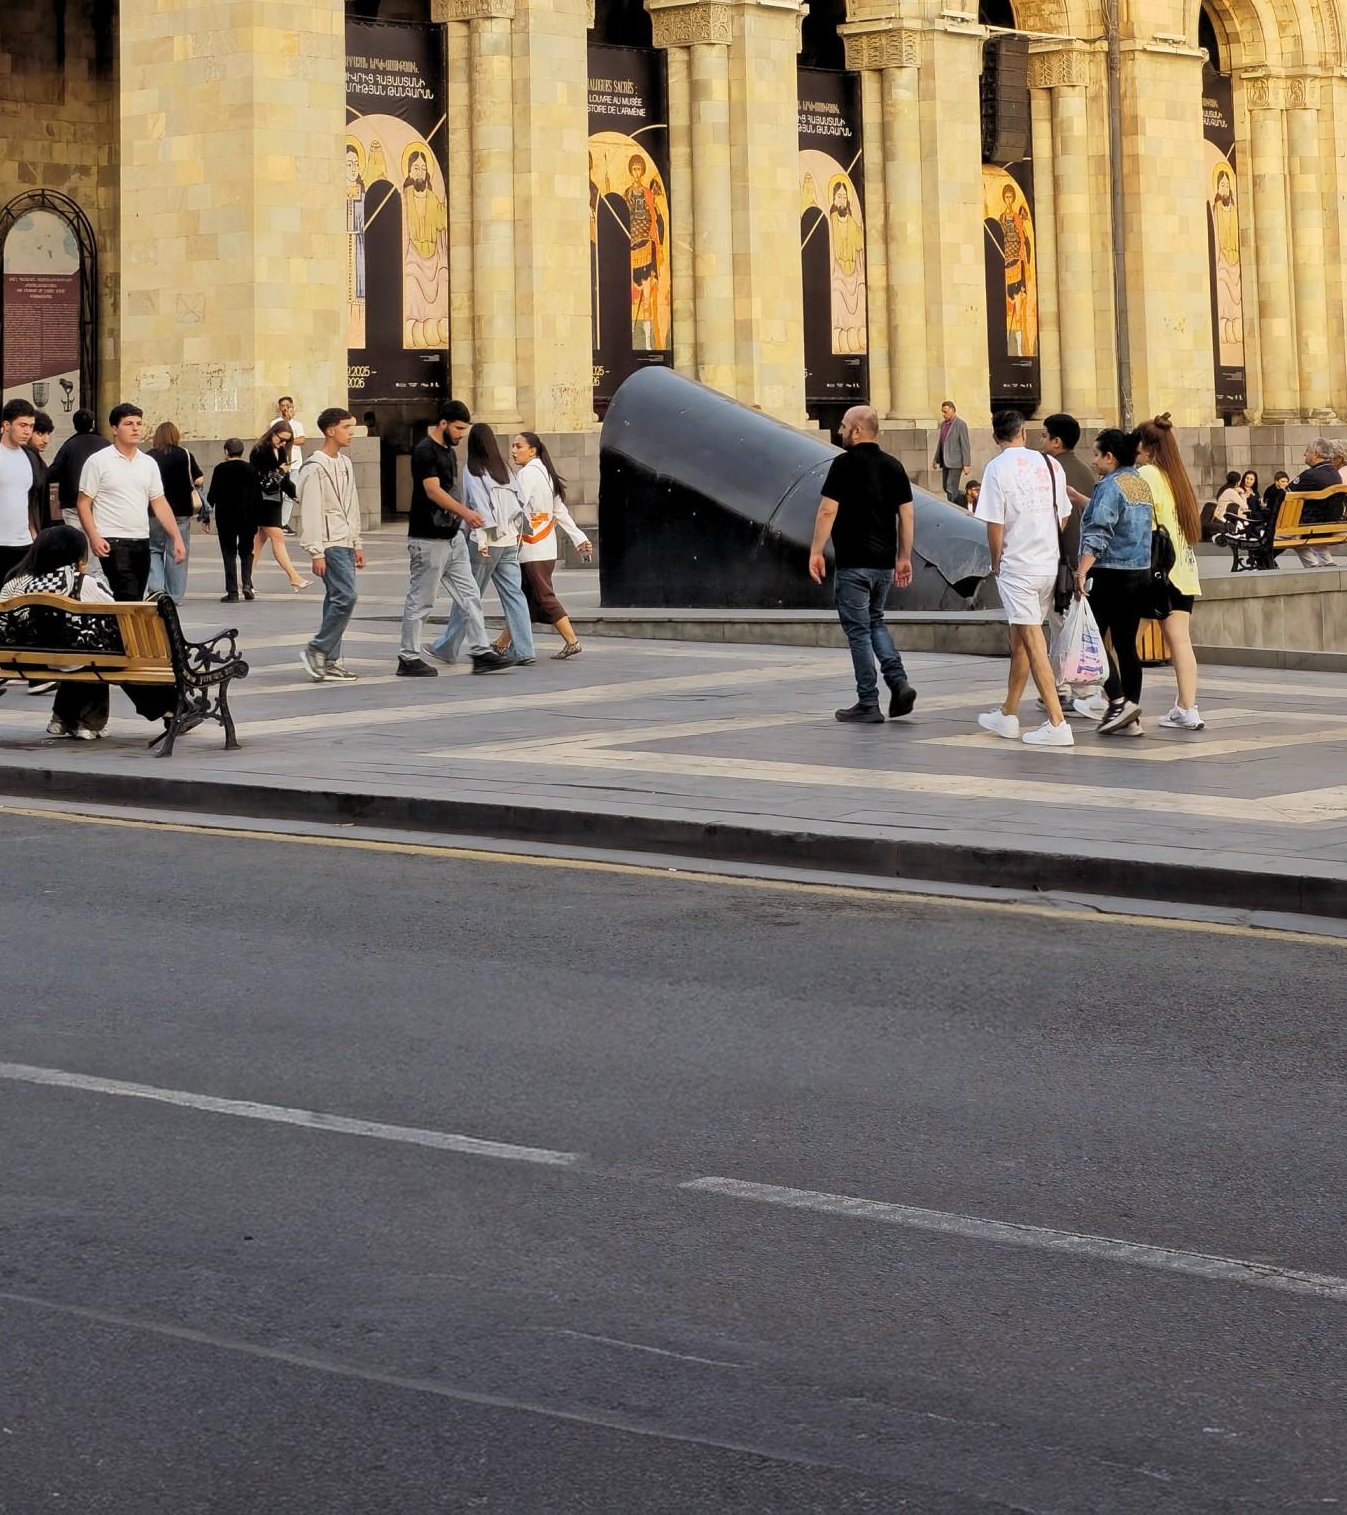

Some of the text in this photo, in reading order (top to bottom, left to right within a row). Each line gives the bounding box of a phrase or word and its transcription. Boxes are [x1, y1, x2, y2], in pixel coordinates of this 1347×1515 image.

[375, 74, 426, 87] ՀԱՅԱՍՏԱՆԻ
[346, 82, 434, 100] ՄՈՒԹՅԱՆ ԹԱՆԳԱՐԱՆ
[589, 94, 643, 106] LOUVRE AU MUSÉE
[587, 104, 607, 114] STOIRE
[608, 105, 616, 114] DE
[592, 366, 605, 376] 025
[592, 376, 600, 387] 26
